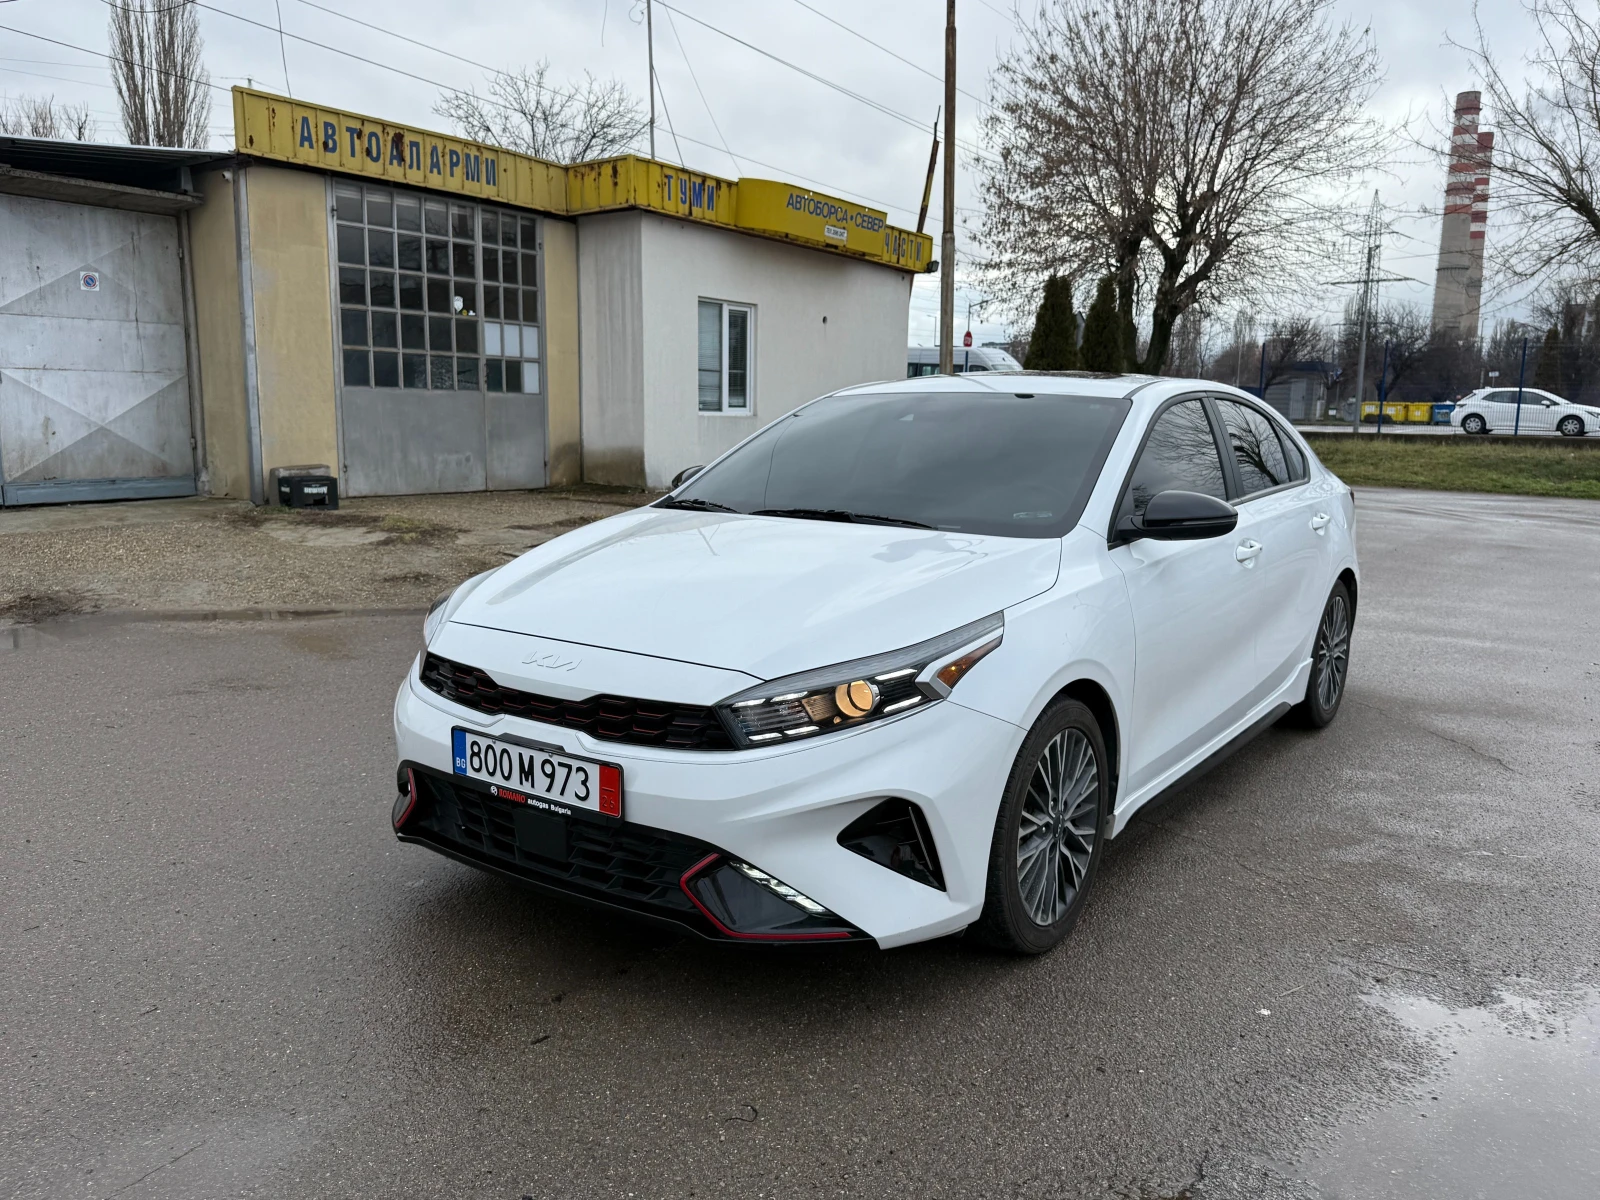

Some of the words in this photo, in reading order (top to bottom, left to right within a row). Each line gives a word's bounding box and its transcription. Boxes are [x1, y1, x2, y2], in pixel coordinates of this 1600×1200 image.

[299, 115, 497, 187] АВТОАЛАРМИ
[786, 193, 849, 224] АВТОБОРСА
[854, 211, 884, 233] СЕВЕР
[885, 232, 923, 262] ЧАСТИ
[456, 757, 466, 769] BG
[498, 788, 527, 804] ROMANO
[527, 798, 549, 810] autogas
[550, 804, 572, 816] Bulgaria
